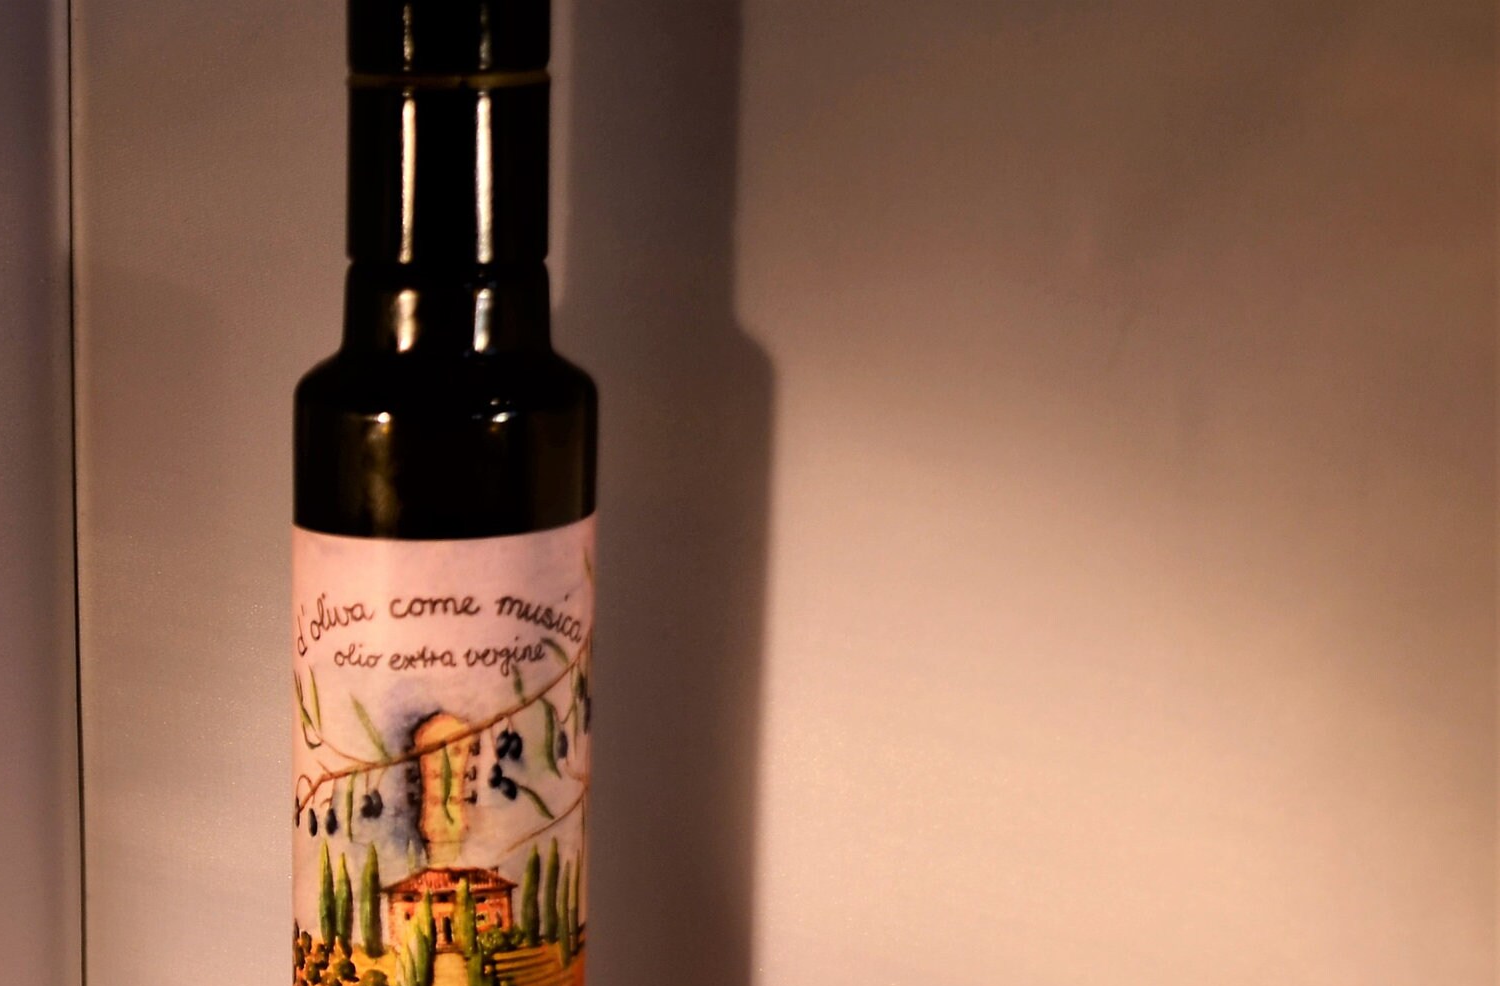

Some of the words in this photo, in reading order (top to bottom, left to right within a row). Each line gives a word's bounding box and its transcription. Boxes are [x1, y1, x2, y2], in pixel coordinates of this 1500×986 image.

[297, 592, 375, 656] d'oliva
[390, 595, 481, 618] come
[495, 594, 582, 643] musica
[334, 643, 383, 668] olio
[389, 646, 457, 671] extra
[464, 636, 546, 677] vergine
